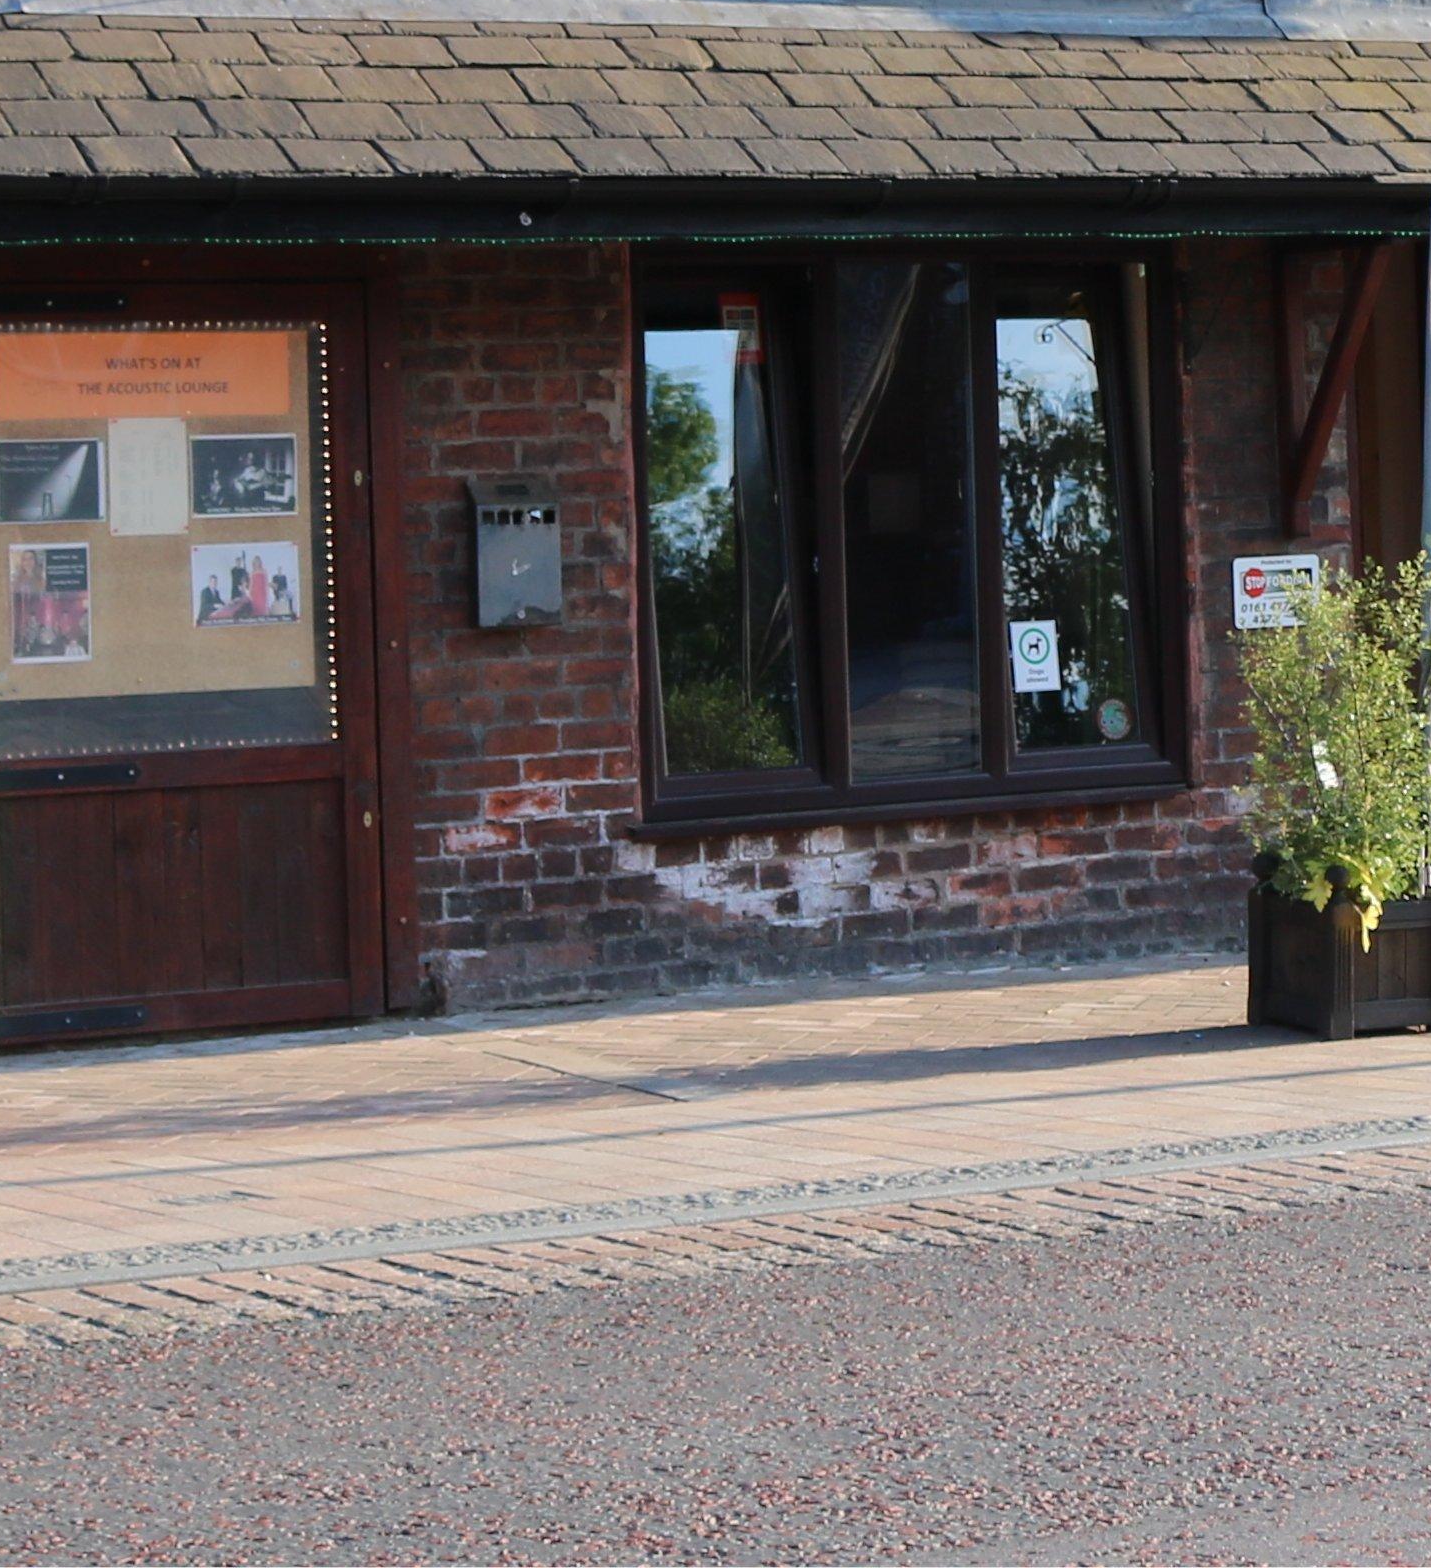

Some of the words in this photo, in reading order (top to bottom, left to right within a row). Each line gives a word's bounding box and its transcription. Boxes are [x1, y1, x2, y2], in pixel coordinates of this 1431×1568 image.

[105, 357, 157, 370] WHAT'S
[161, 357, 181, 369] ON
[184, 357, 201, 369] AT
[78, 383, 101, 395] THE
[107, 382, 170, 394] ACOUSTIC
[175, 381, 229, 394] LOUNGE
